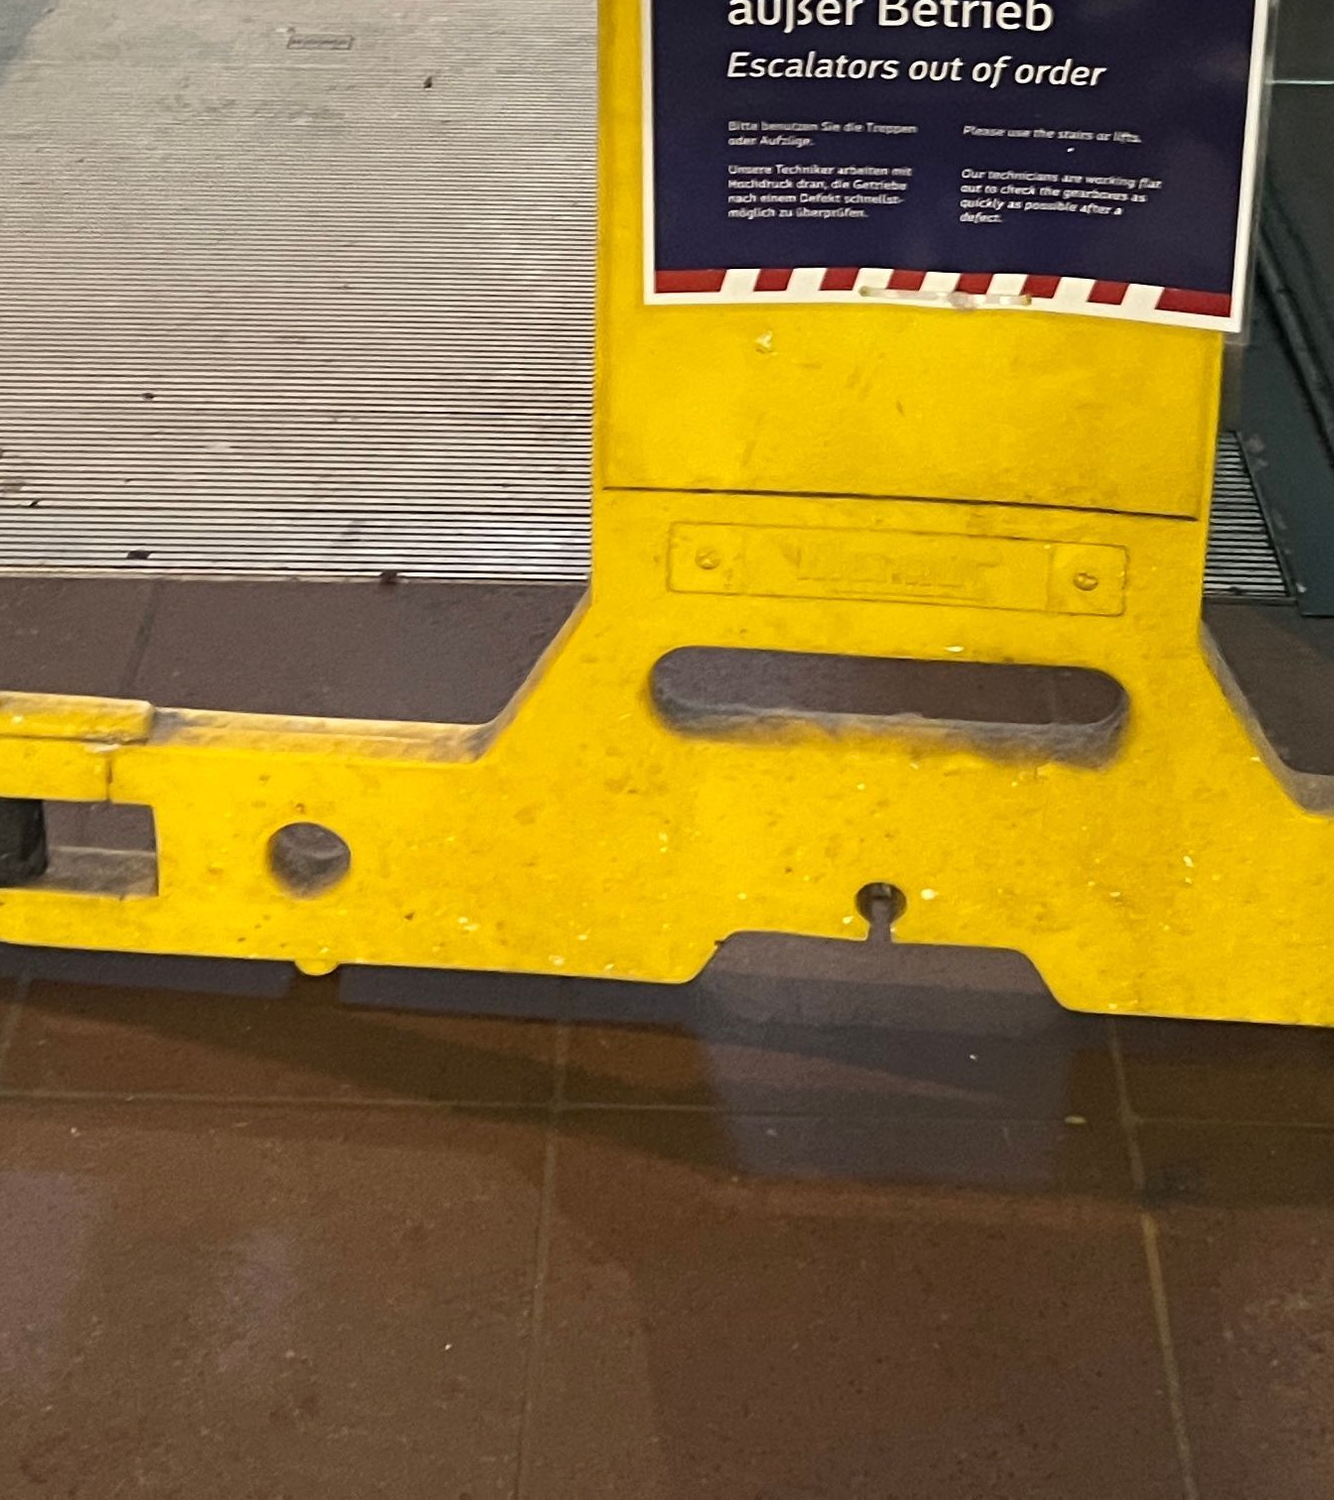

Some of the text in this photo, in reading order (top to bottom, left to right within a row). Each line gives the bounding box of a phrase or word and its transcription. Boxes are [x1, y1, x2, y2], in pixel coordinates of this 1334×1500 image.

[727, 52, 1106, 88] Escalators out of order
[728, 121, 917, 134] Bitte benutzen Sie die Treppen
[963, 125, 1005, 136] Please
[1033, 129, 1054, 138] the
[1057, 130, 1094, 140] stairs
[1096, 133, 1110, 141] or
[1113, 131, 1142, 143] lifts.
[728, 136, 814, 148] oder Aufzüge.
[728, 165, 912, 176] Unsere Techniker arbeiten mit
[962, 168, 1162, 189] Our technicians are working flat
[728, 180, 907, 190] Hochdruck dran, die Getriebe
[728, 194, 904, 204] nach einem Defekt schnellst-
[961, 185, 1147, 202] out to check the gearboxes as
[960, 199, 1123, 215] quickly as possible after a
[728, 208, 868, 219] möglich zu überprüfen.
[960, 213, 1002, 223] defect.
